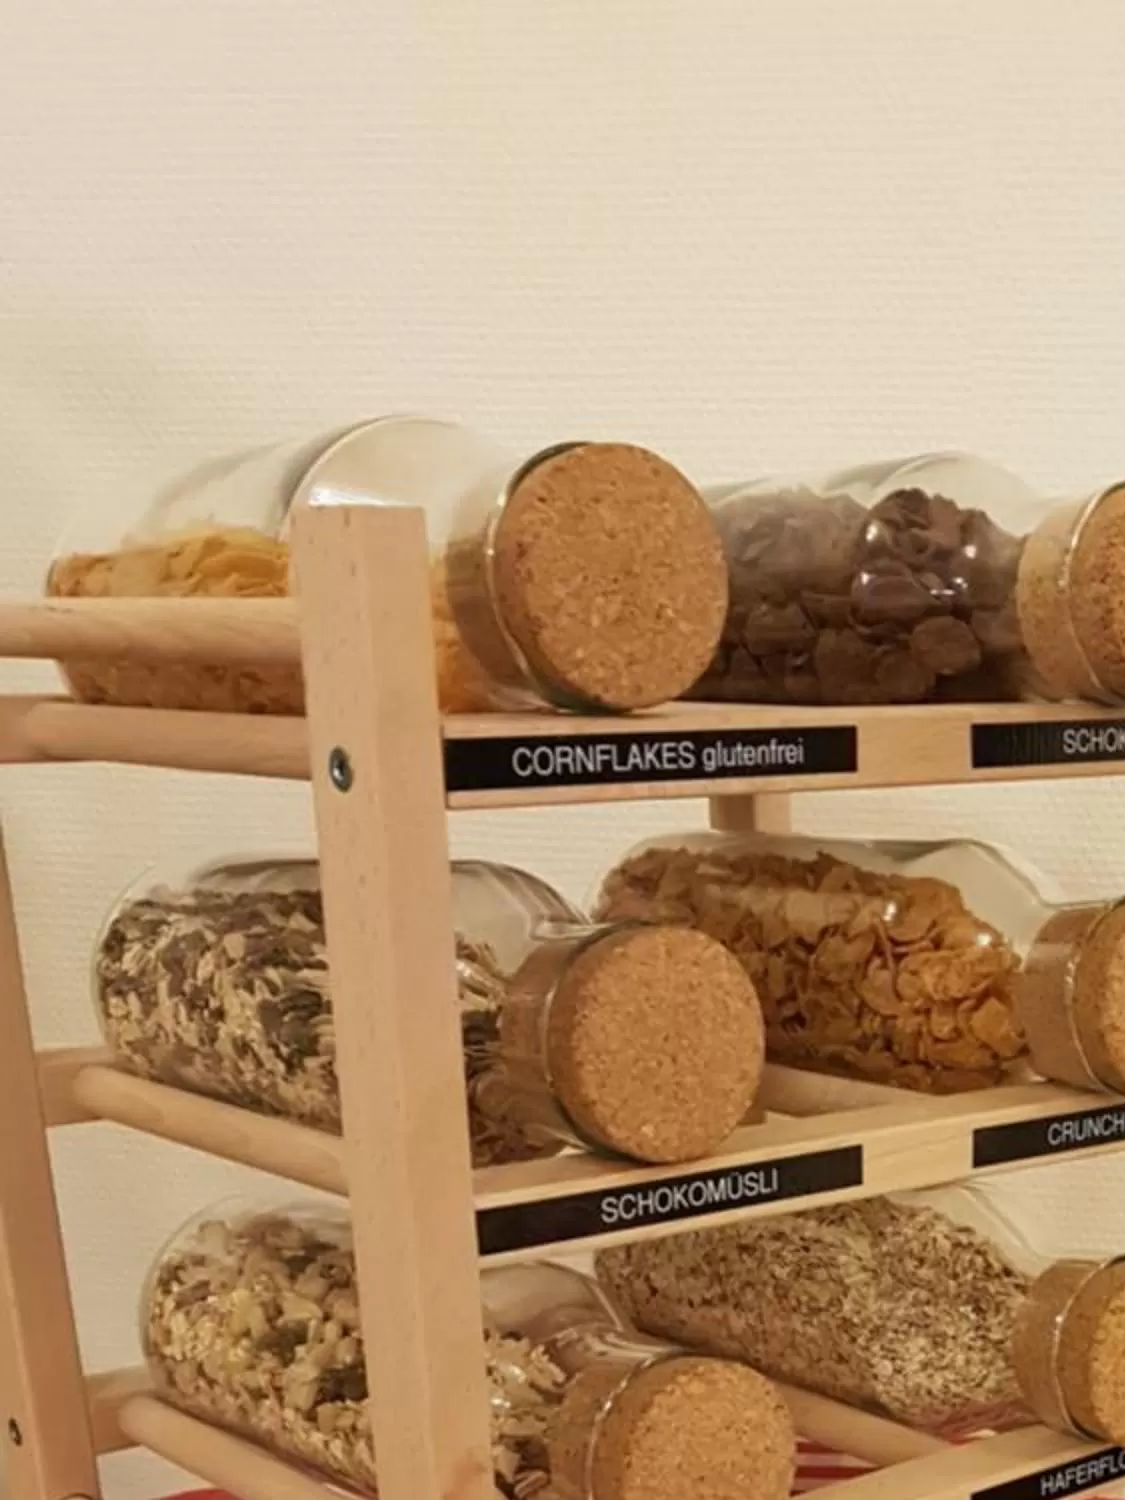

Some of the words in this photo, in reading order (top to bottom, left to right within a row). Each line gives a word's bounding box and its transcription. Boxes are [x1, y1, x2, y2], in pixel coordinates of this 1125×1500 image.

[512, 741, 696, 777] CORNFLAKES
[702, 737, 805, 772] glutenfrei
[1047, 1112, 1125, 1146] CRUNCH
[600, 1167, 779, 1223] SCHOKOMÜSLI
